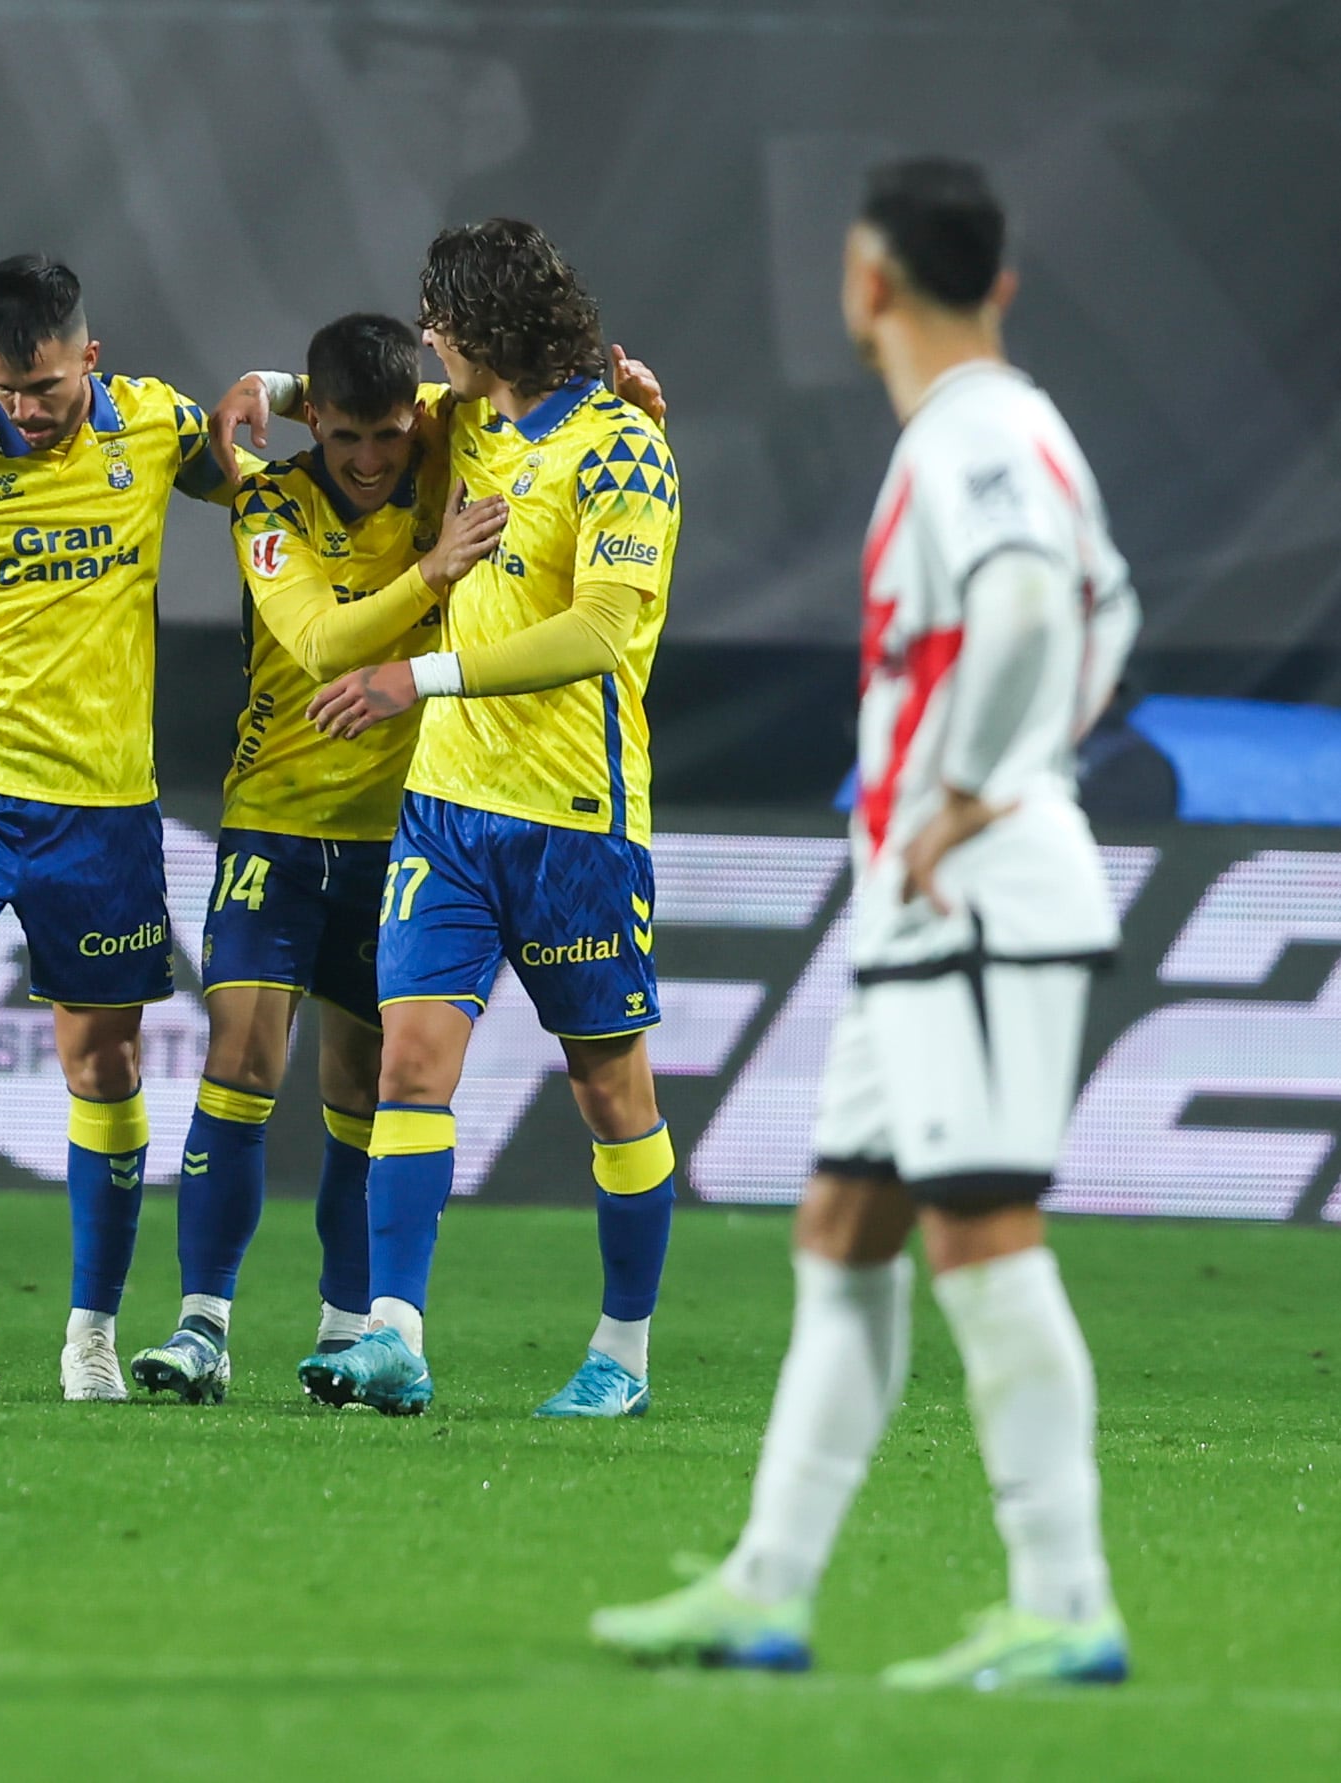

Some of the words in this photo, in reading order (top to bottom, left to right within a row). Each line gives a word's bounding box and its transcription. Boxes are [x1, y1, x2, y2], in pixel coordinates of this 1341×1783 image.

[12, 523, 114, 557] Gran
[588, 530, 658, 567] Kalise
[213, 852, 272, 912] 14
[79, 914, 167, 957] Cordial
[521, 932, 620, 966] Cordial
